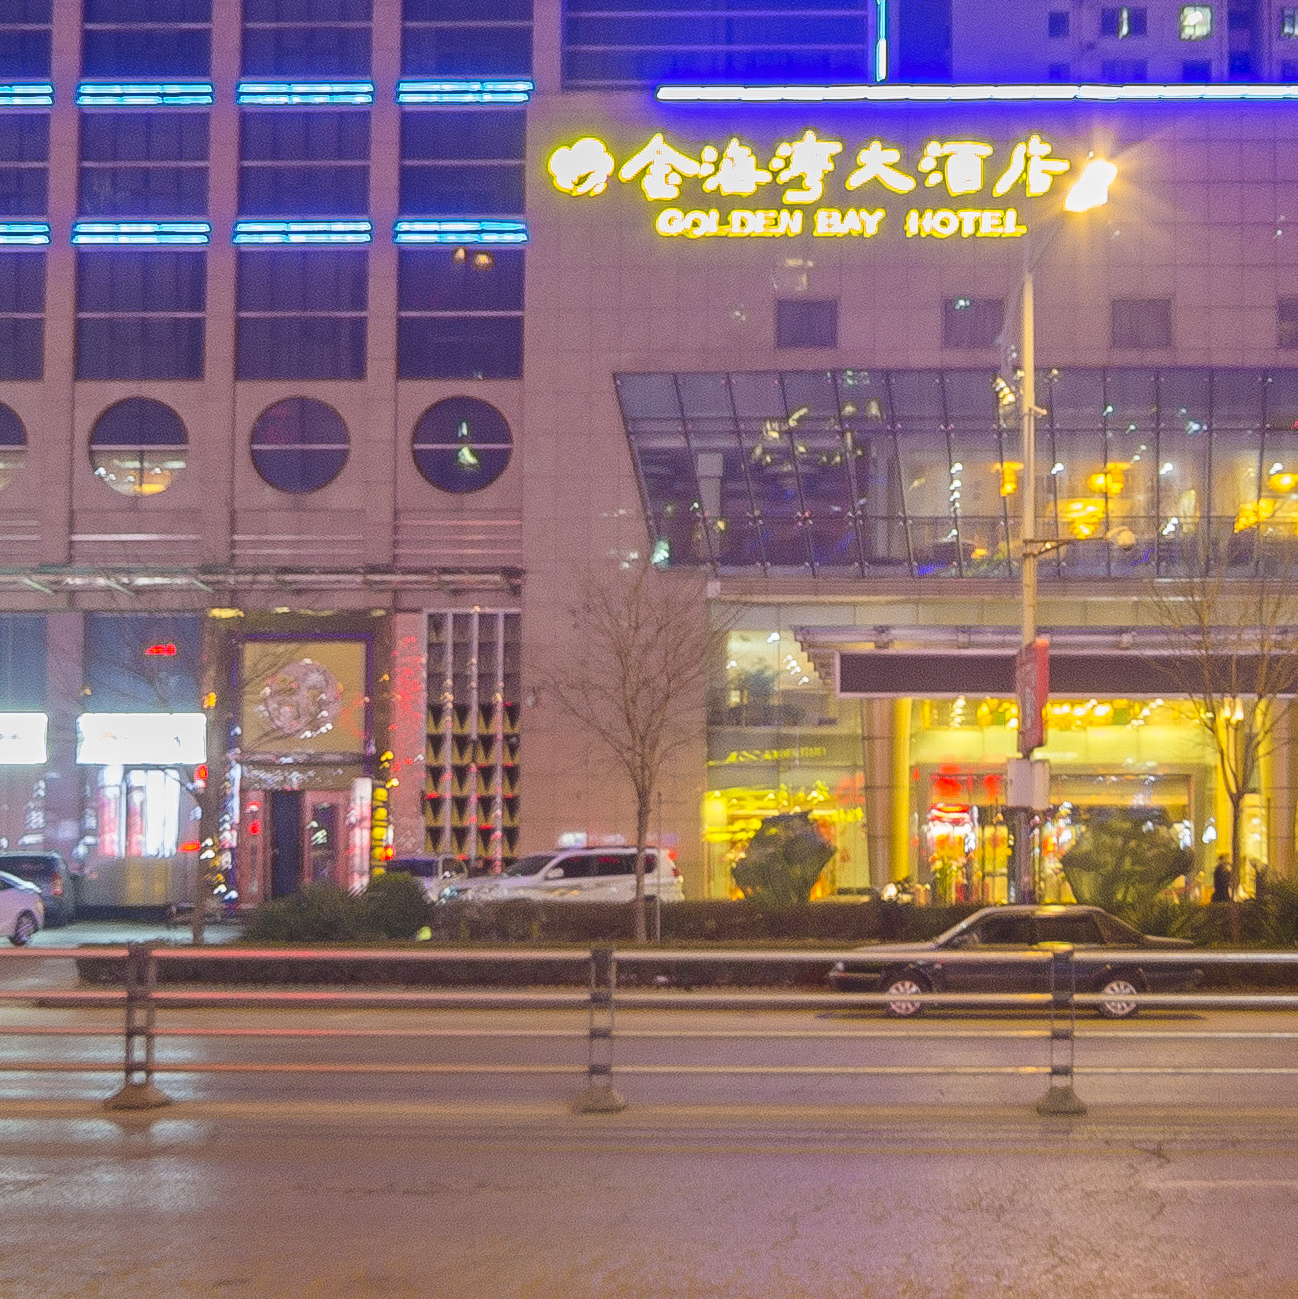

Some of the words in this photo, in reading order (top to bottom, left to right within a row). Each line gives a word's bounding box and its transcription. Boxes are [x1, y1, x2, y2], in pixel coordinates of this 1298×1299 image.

[656, 207, 803, 239] GOLDEN
[813, 208, 886, 238] BAY
[904, 208, 1027, 238] HOTEL
